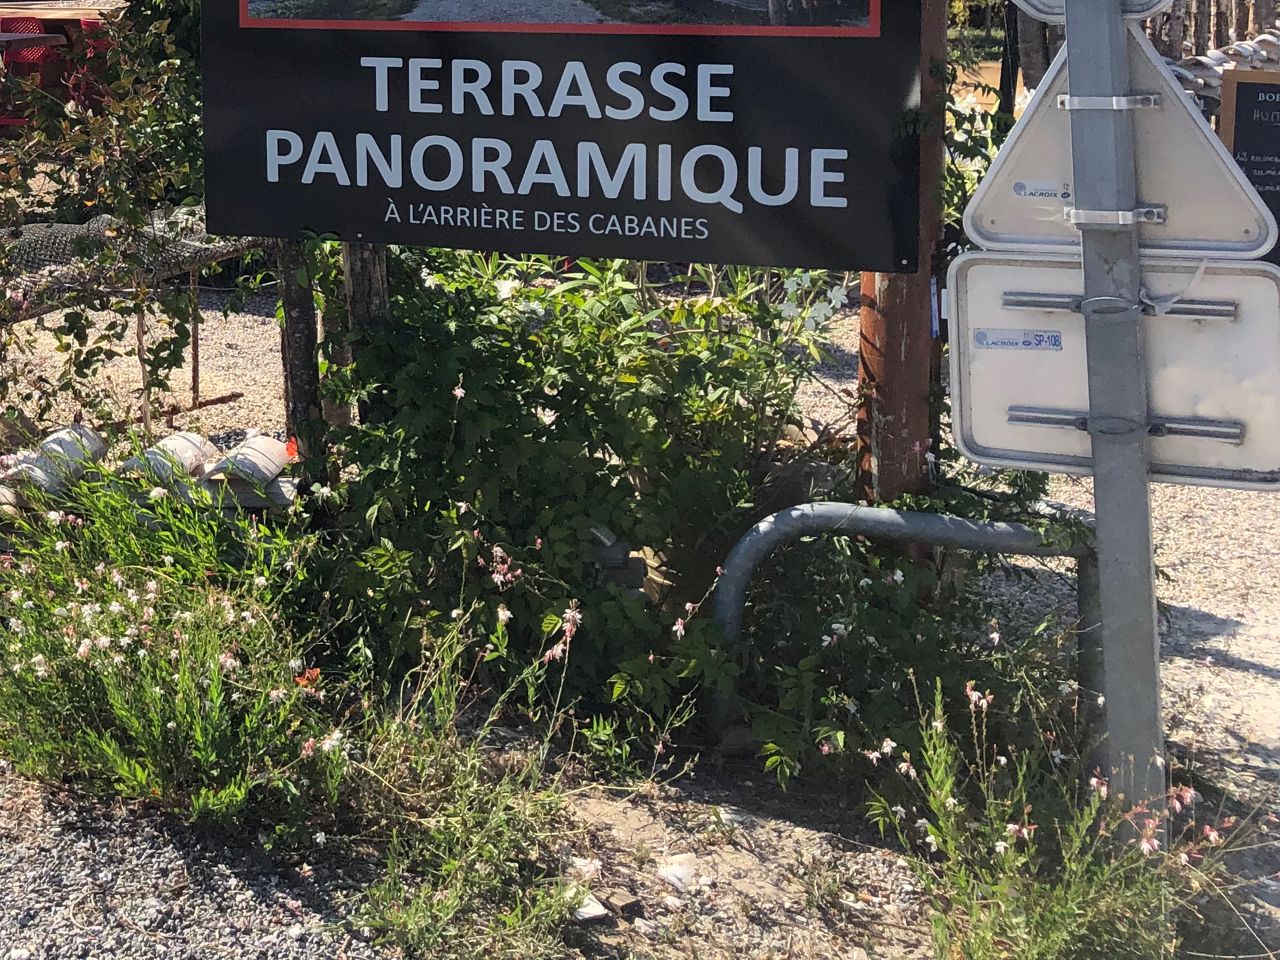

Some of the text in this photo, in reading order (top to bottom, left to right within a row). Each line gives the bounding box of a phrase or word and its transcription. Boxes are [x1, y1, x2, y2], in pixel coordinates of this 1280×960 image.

[360, 56, 734, 122] TERRASSE
[266, 129, 849, 214] PANORAMIQUE
[384, 198, 401, 223] À
[534, 210, 581, 233] DES
[588, 213, 709, 240] CABANES
